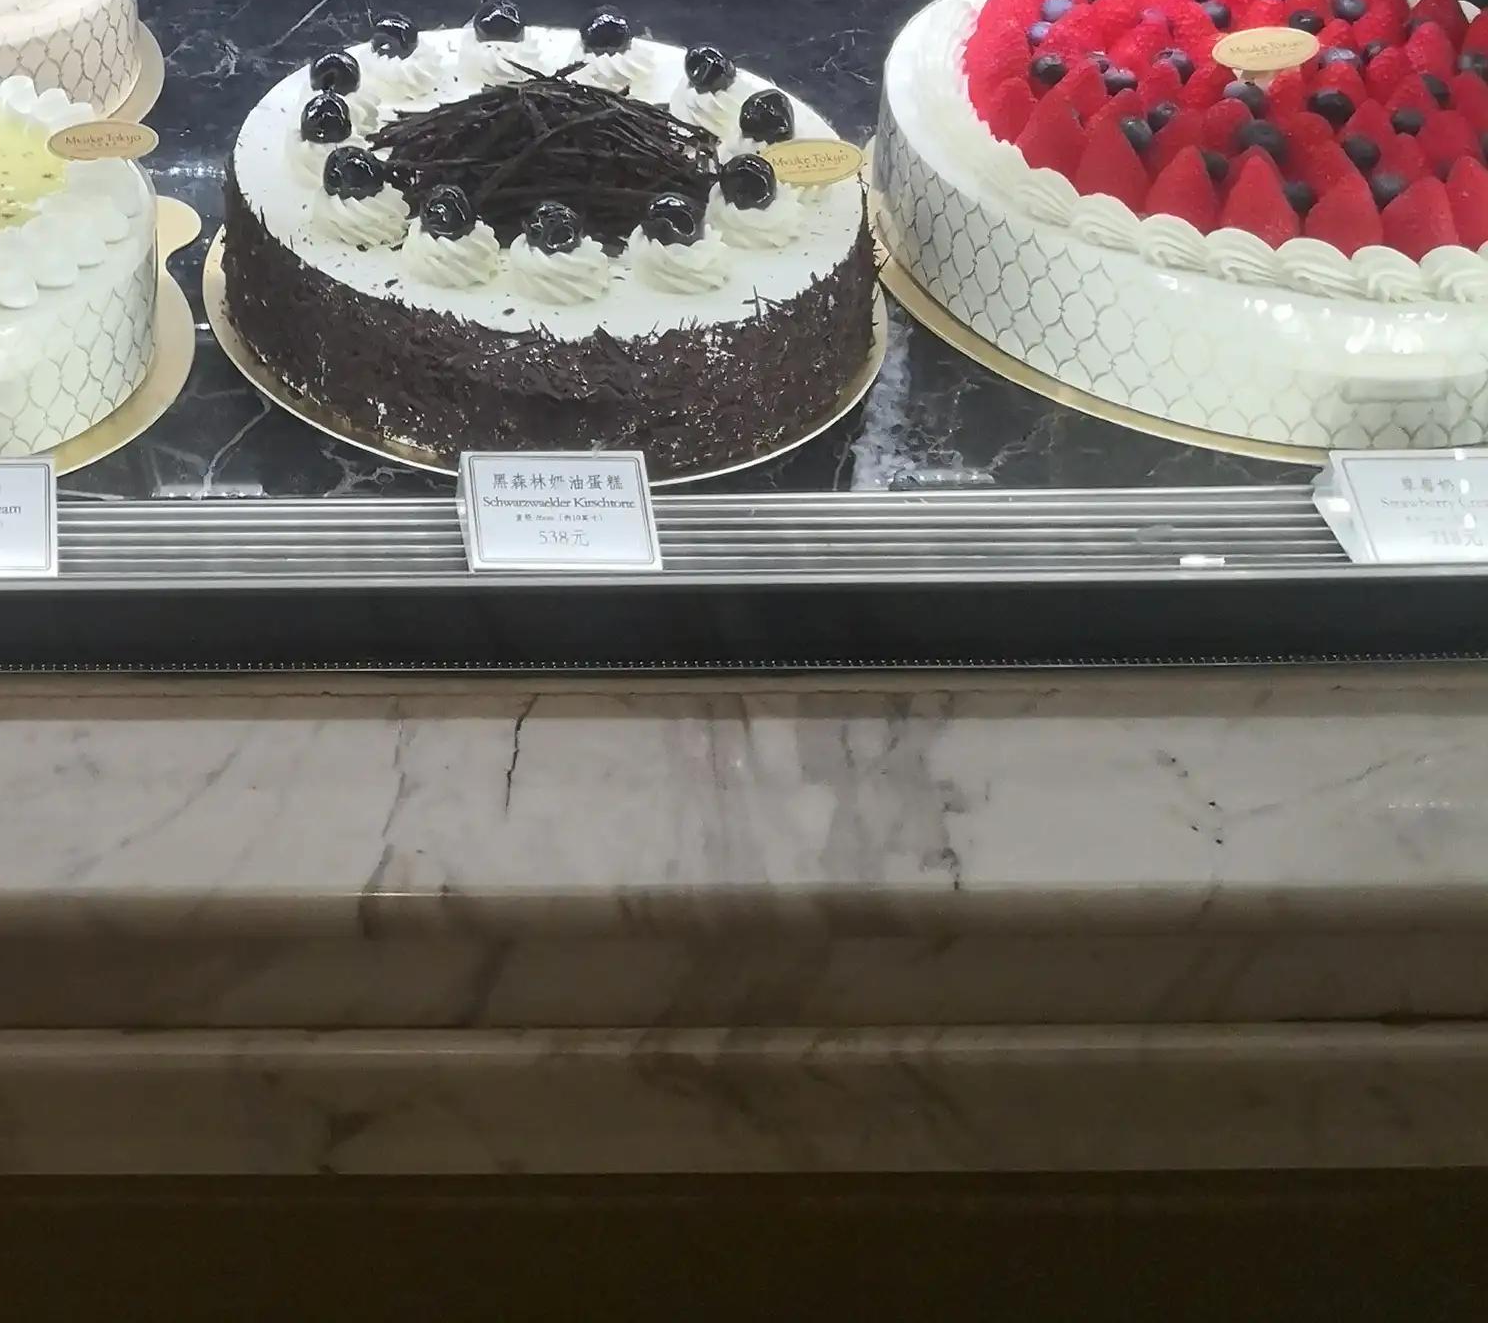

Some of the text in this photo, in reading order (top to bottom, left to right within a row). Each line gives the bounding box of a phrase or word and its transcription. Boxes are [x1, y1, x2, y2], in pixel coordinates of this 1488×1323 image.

[492, 472, 623, 491] 黑森林奶油蛋糕
[483, 496, 571, 508] Schwarzwaelder
[539, 529, 589, 547] 538元
